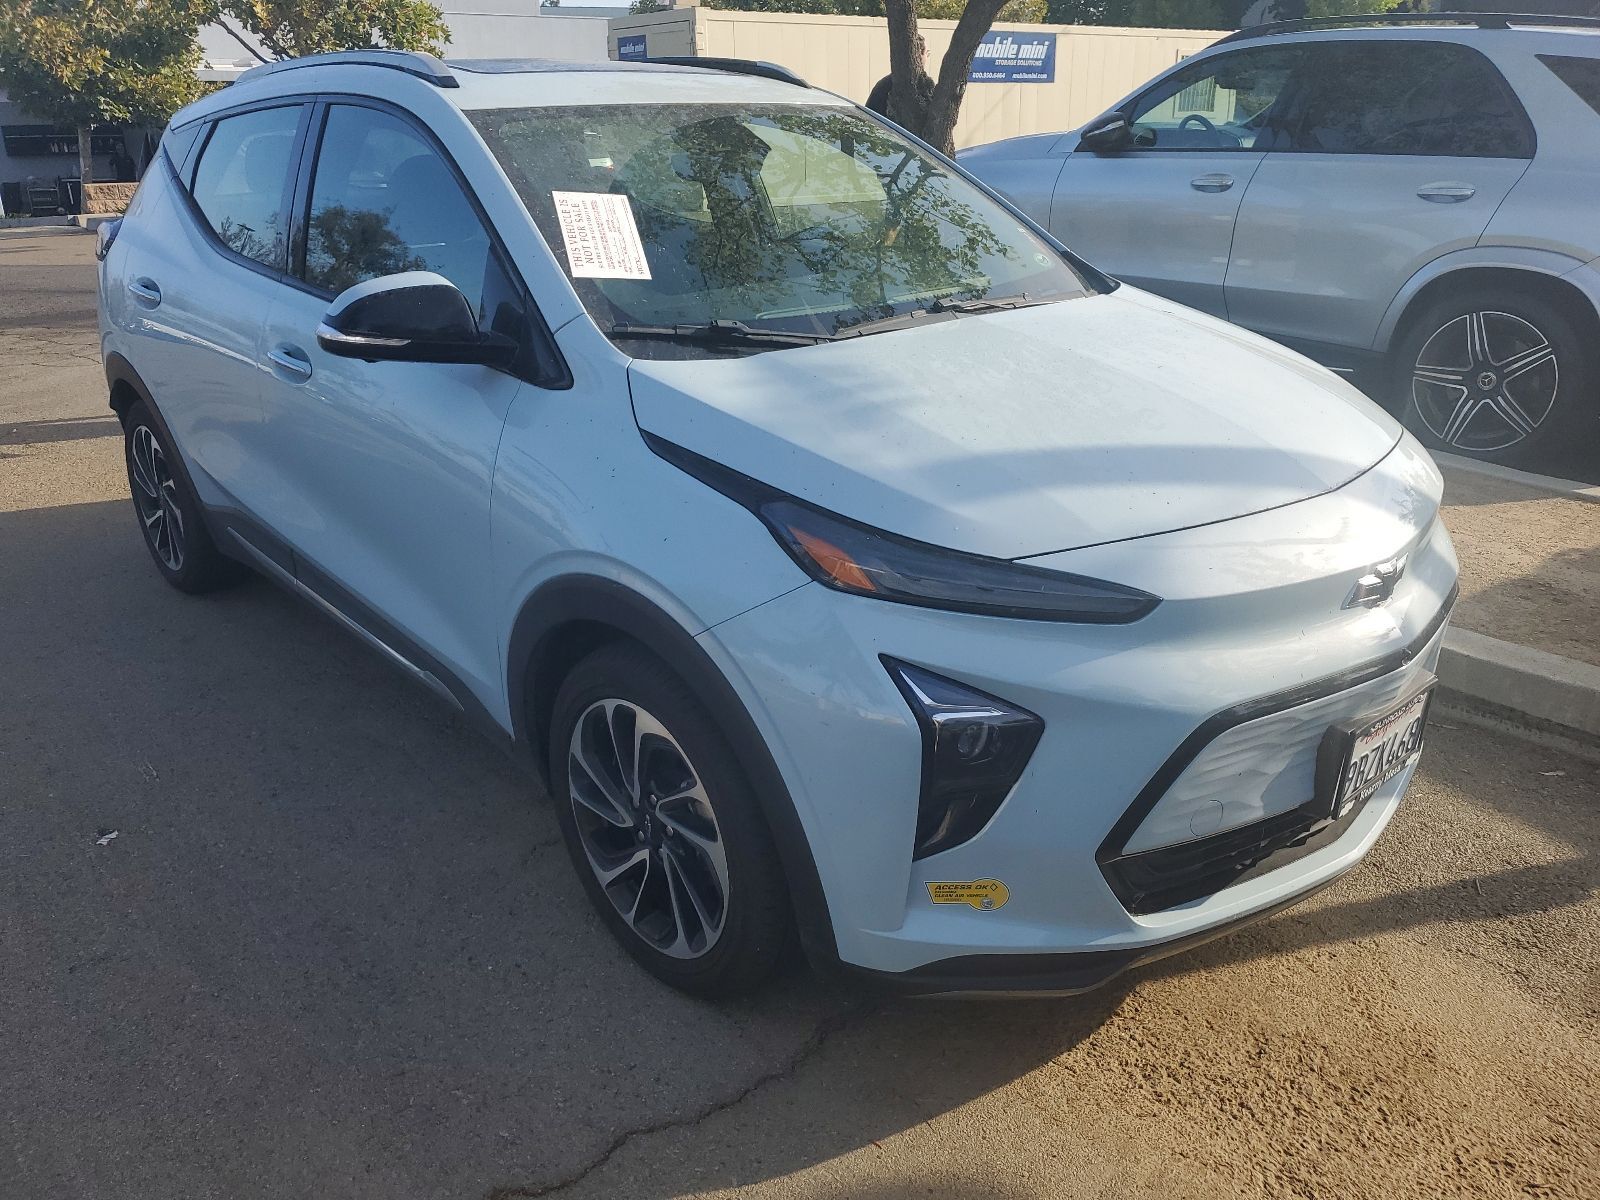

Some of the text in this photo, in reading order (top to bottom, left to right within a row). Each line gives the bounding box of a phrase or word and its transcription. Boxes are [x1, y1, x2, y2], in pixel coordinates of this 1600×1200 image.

[1018, 41, 1050, 59] mini
[1017, 59, 1043, 67] SOLUTIONS
[571, 203, 582, 222] SALE
[562, 209, 577, 244] VEHICLE
[576, 225, 588, 241] FOR
[571, 247, 584, 267] THIS
[582, 245, 594, 263] NOT
[1359, 764, 1401, 801] Kearny Mesa
